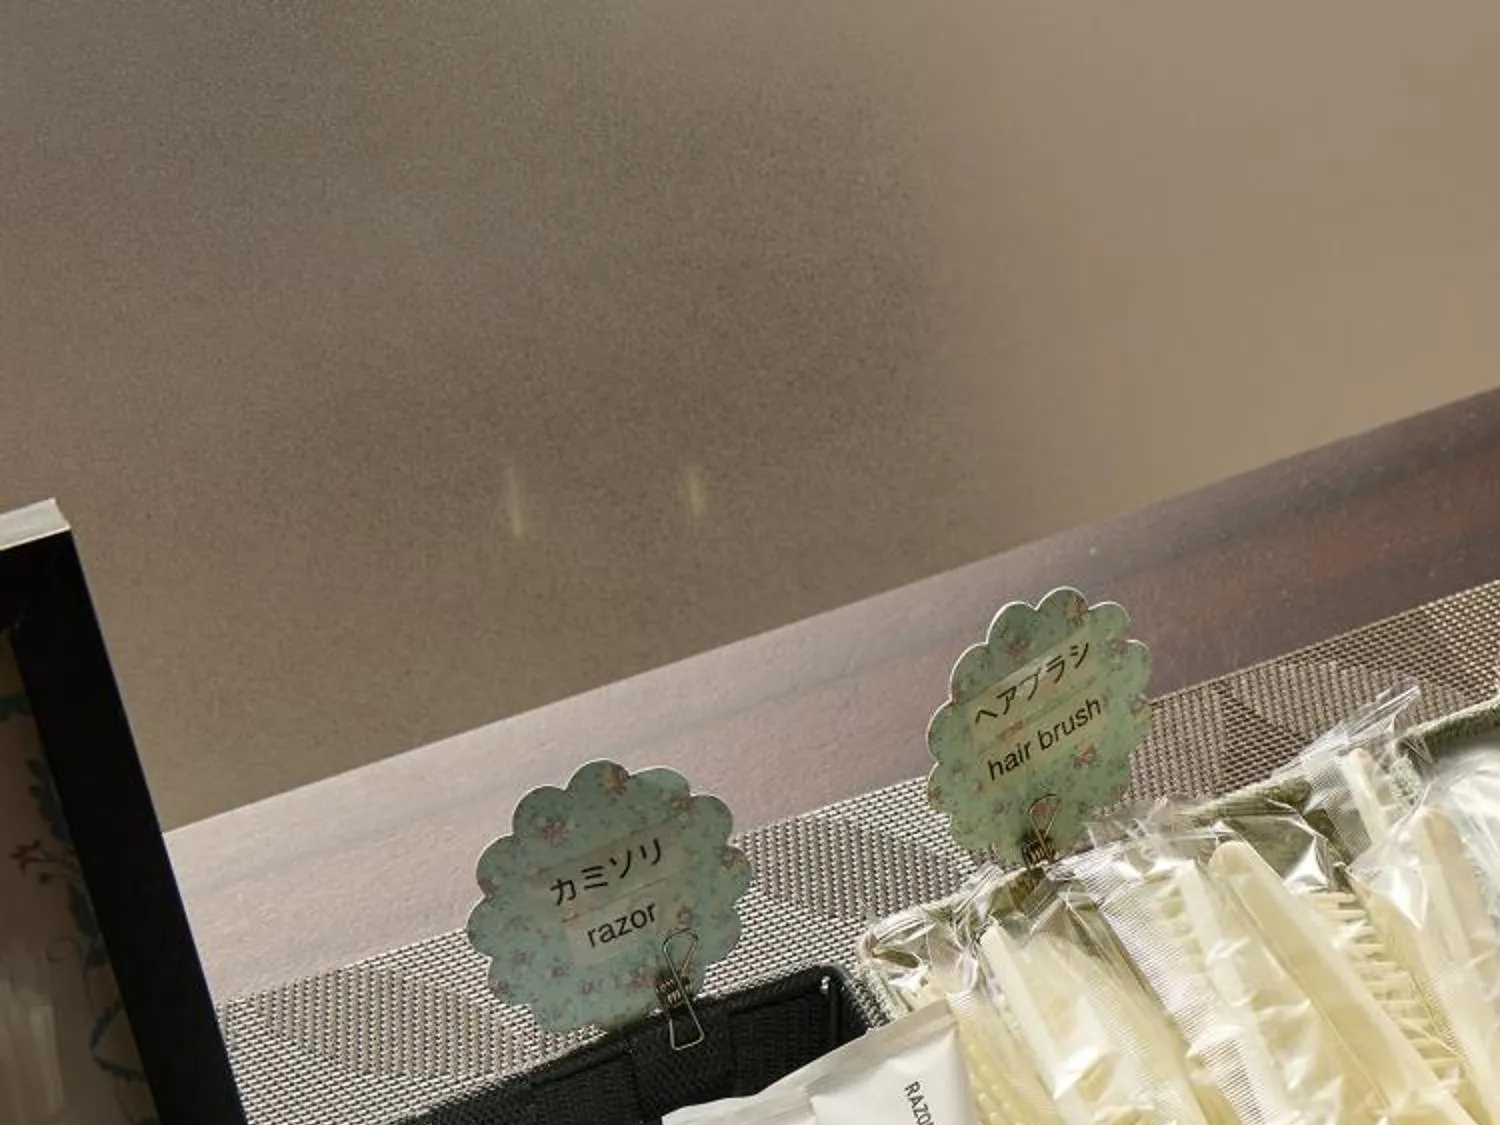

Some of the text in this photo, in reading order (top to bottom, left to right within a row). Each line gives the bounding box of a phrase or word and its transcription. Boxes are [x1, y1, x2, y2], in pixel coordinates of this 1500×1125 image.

[987, 697, 1102, 781] hair brush
[549, 838, 663, 906] カミソリ
[586, 902, 657, 948] razor
